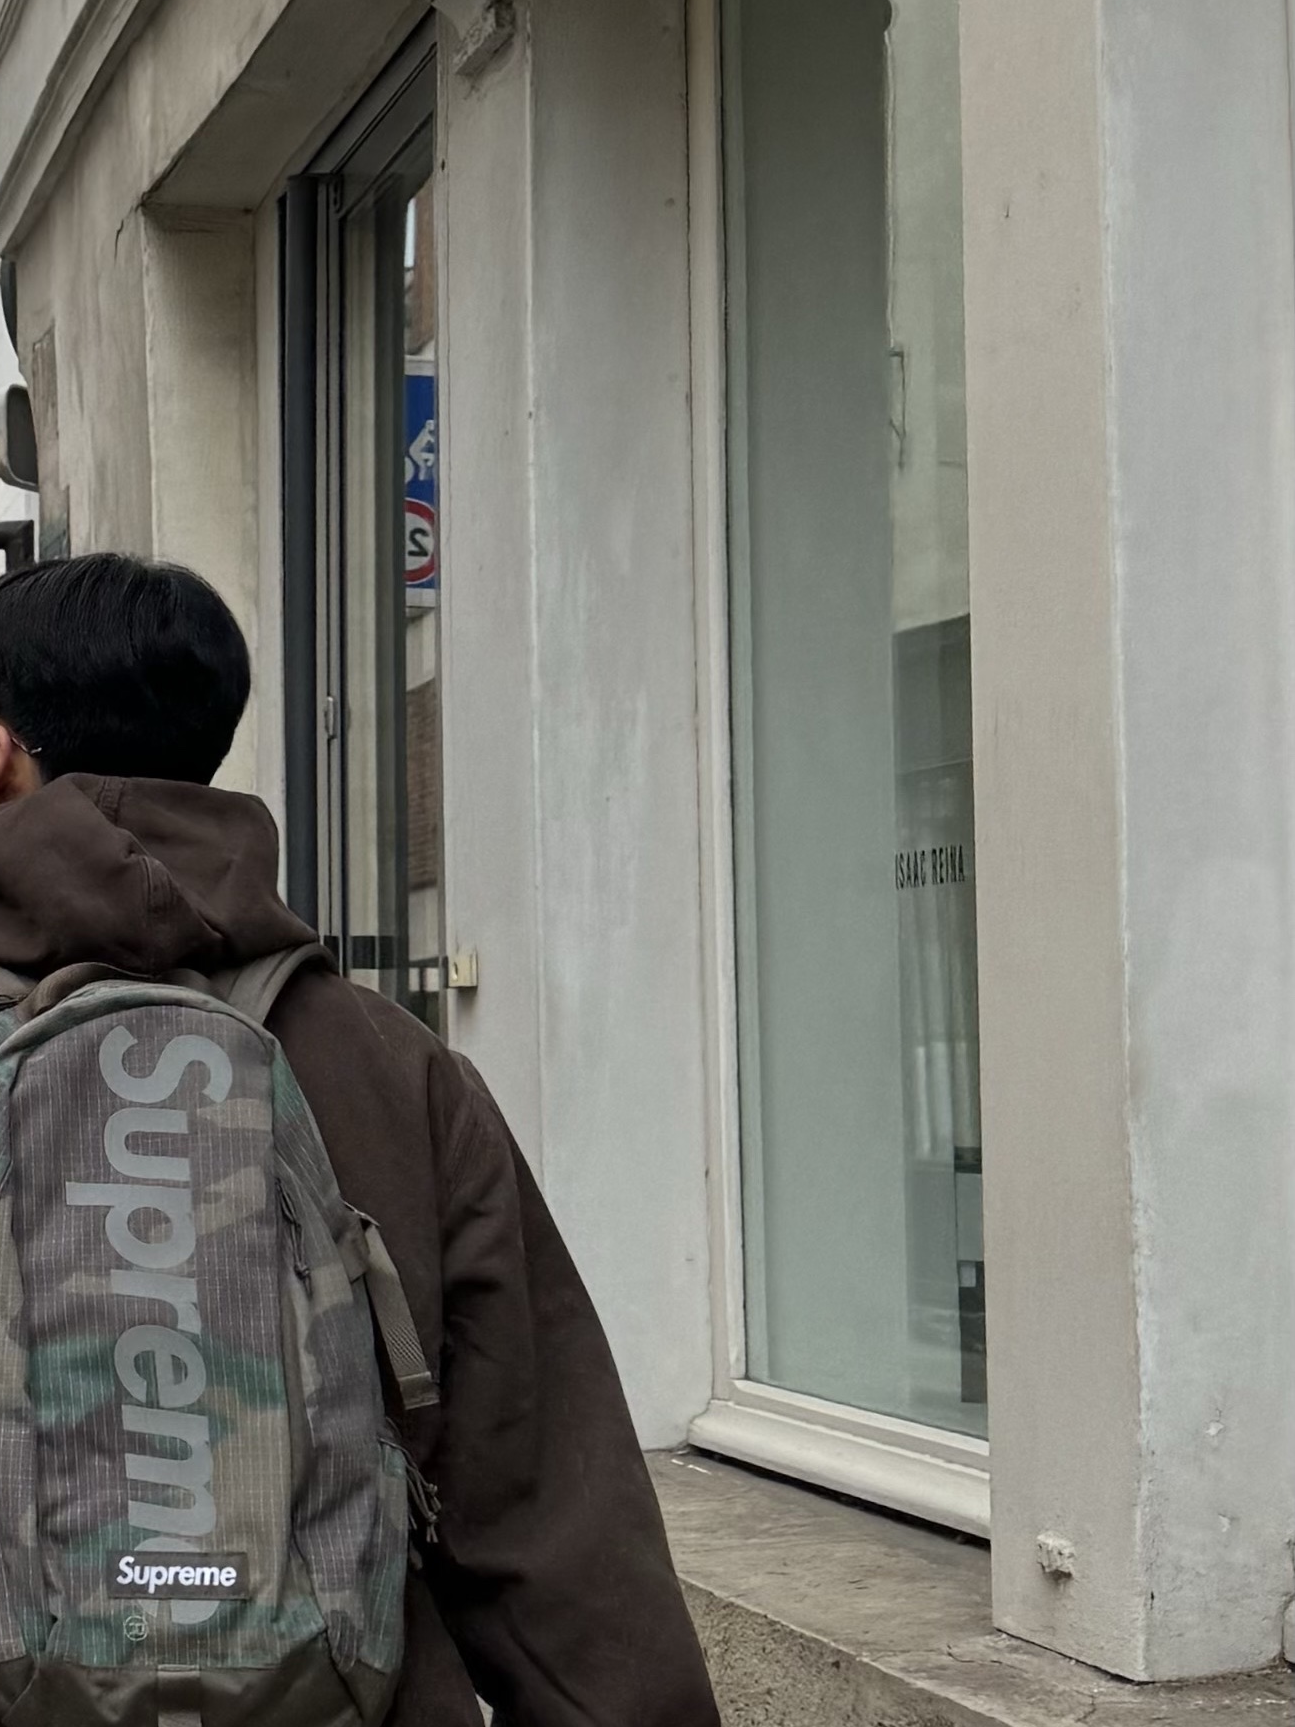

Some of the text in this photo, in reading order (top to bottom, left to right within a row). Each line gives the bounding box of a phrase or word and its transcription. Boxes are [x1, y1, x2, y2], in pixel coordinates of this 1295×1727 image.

[895, 844, 966, 890] ISAAC REINA
[116, 1556, 237, 1594] Supreme
